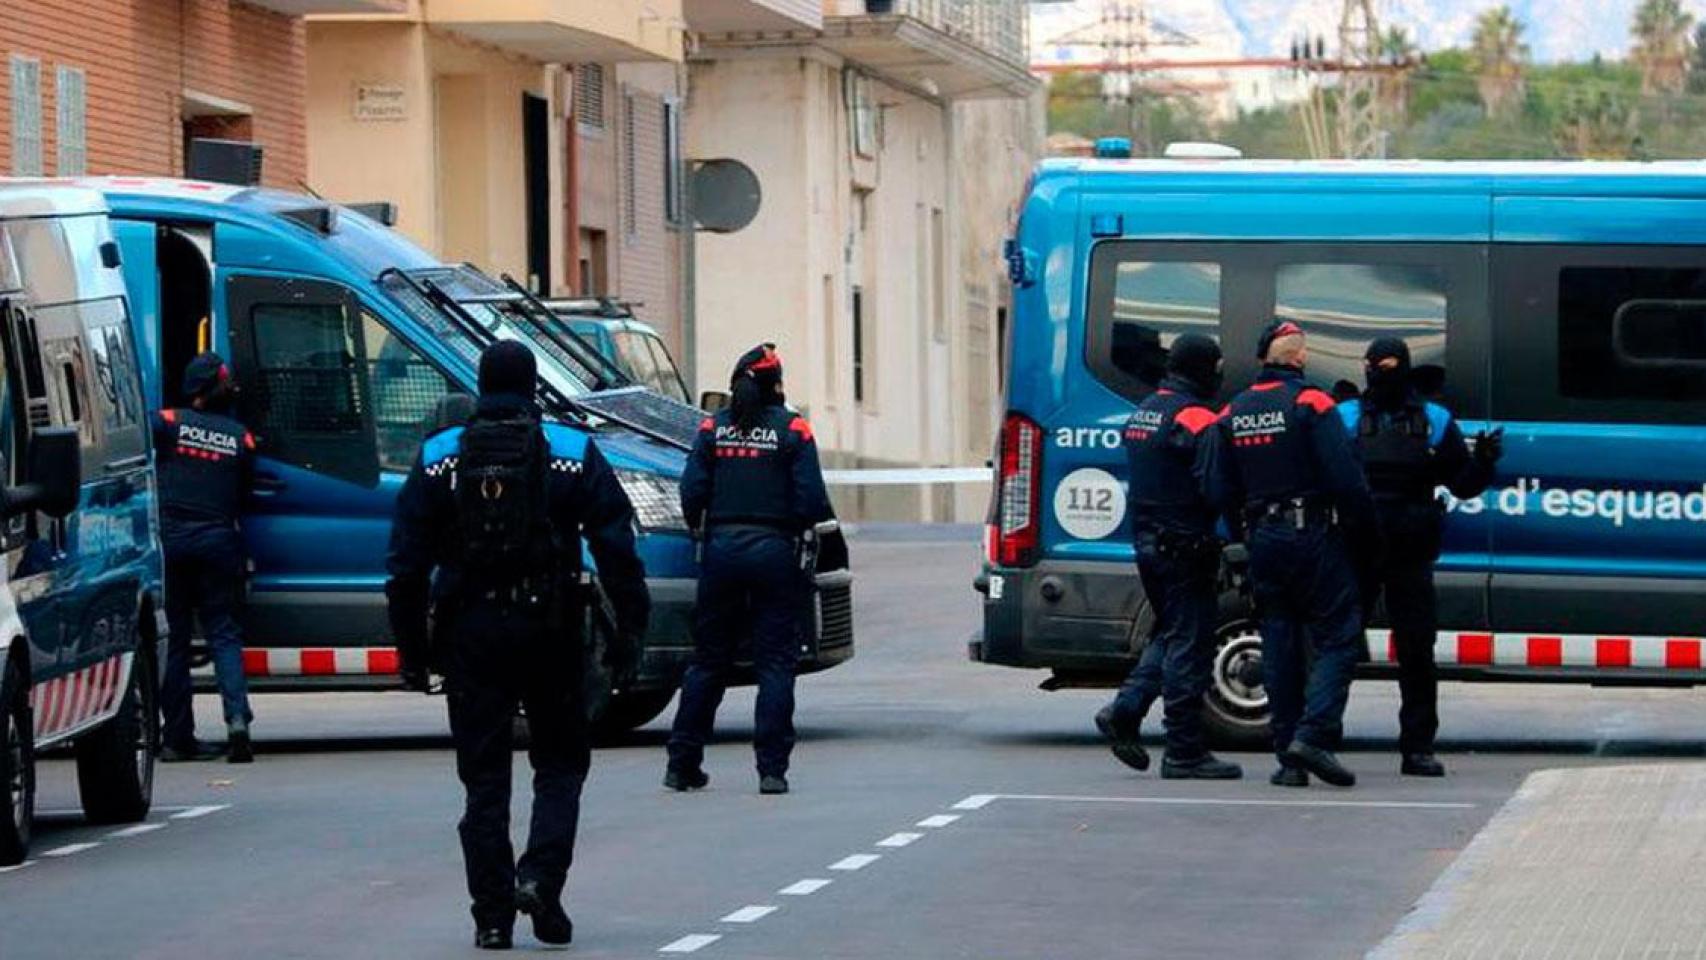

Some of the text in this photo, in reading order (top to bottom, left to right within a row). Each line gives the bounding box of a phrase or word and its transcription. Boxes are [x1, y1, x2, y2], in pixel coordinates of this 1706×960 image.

[1231, 410, 1286, 431] POLICIA
[179, 423, 237, 449] POLICIA
[715, 426, 779, 443] POLCIA
[1055, 426, 1121, 449] arro
[1067, 487, 1112, 512] 112
